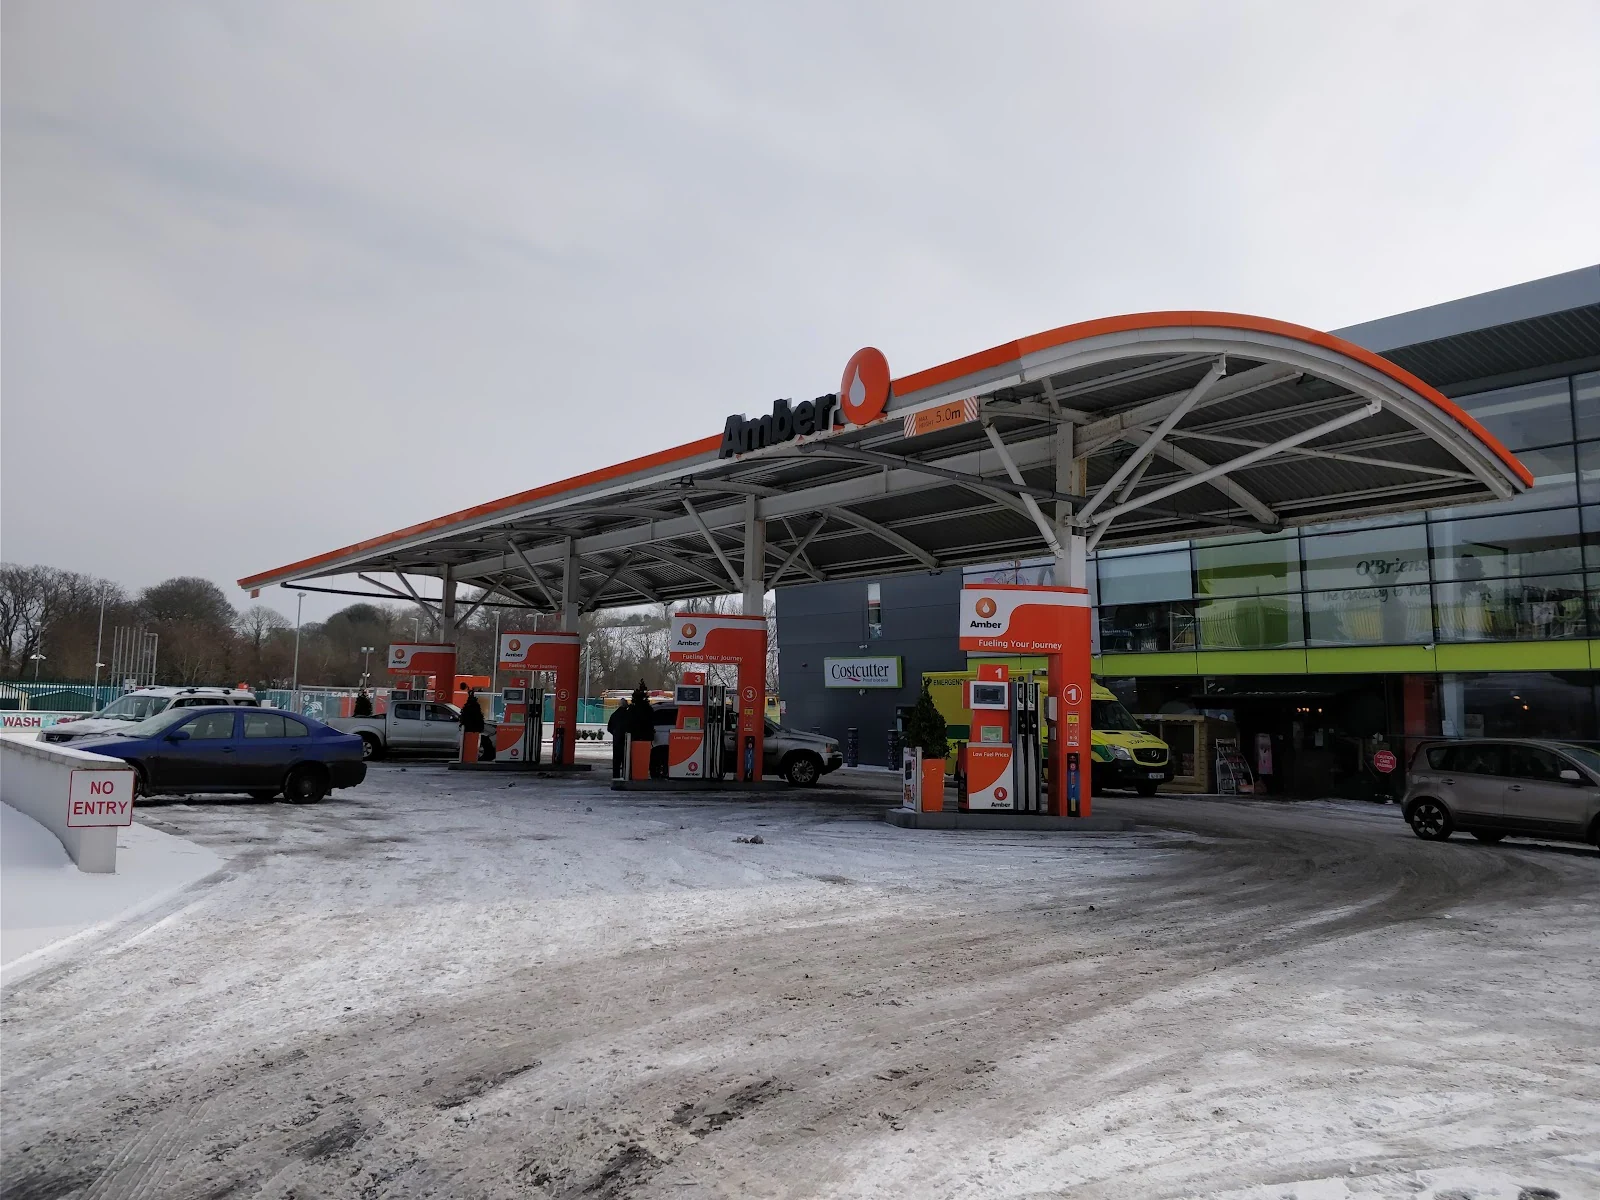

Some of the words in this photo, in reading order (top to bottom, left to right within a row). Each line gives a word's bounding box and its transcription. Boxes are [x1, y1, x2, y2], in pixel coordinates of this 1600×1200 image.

[936, 408, 961, 423] 5.0m
[719, 393, 836, 459] Amber
[1356, 558, 1428, 576] O'Briens
[970, 621, 1002, 629] Amber
[978, 640, 1008, 648] Fueling
[1011, 640, 1030, 648] Your
[1031, 641, 1063, 650] Journey
[831, 663, 890, 679] Costcutter
[995, 668, 1003, 679] 1
[694, 674, 702, 683] 3
[746, 690, 753, 698] 3
[1067, 688, 1077, 700] 1
[3, 716, 41, 727] WASH
[91, 781, 114, 794] NO
[73, 801, 128, 815] ENTRY
